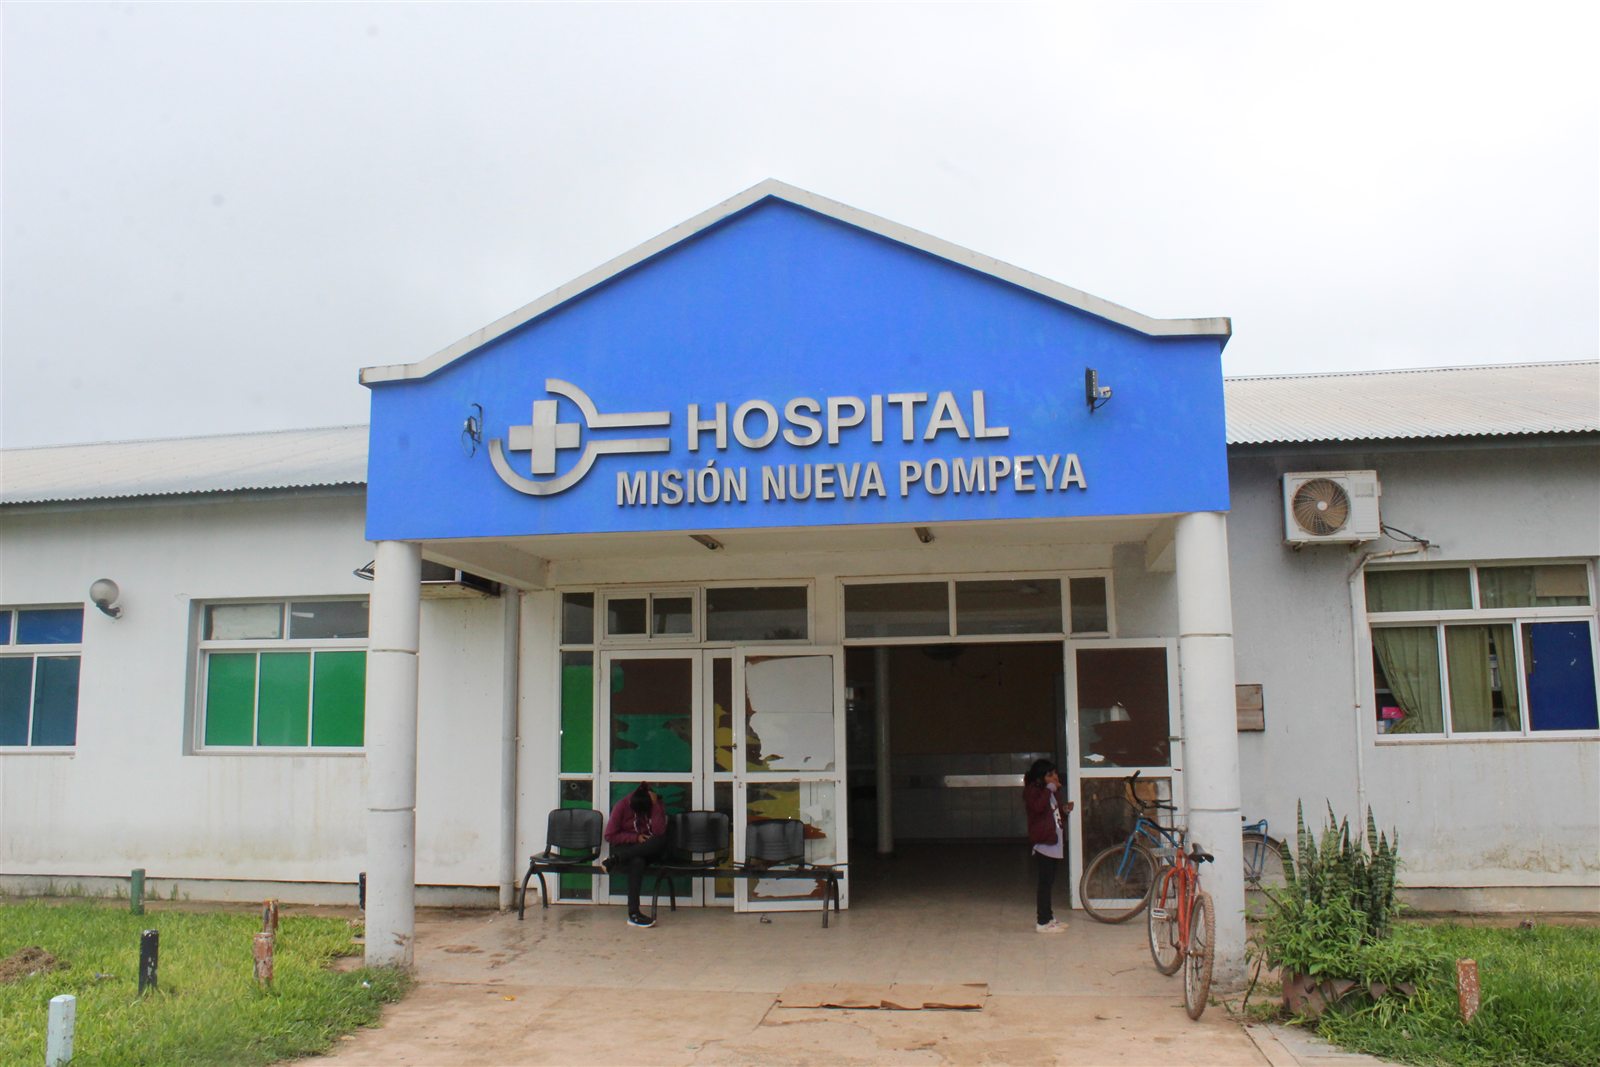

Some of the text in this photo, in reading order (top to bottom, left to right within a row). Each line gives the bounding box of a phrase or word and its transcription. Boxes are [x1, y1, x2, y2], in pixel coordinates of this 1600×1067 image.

[687, 389, 1010, 451] HOSPITAL
[616, 453, 1088, 506] MISIÓN NUEVA POMPEYA
